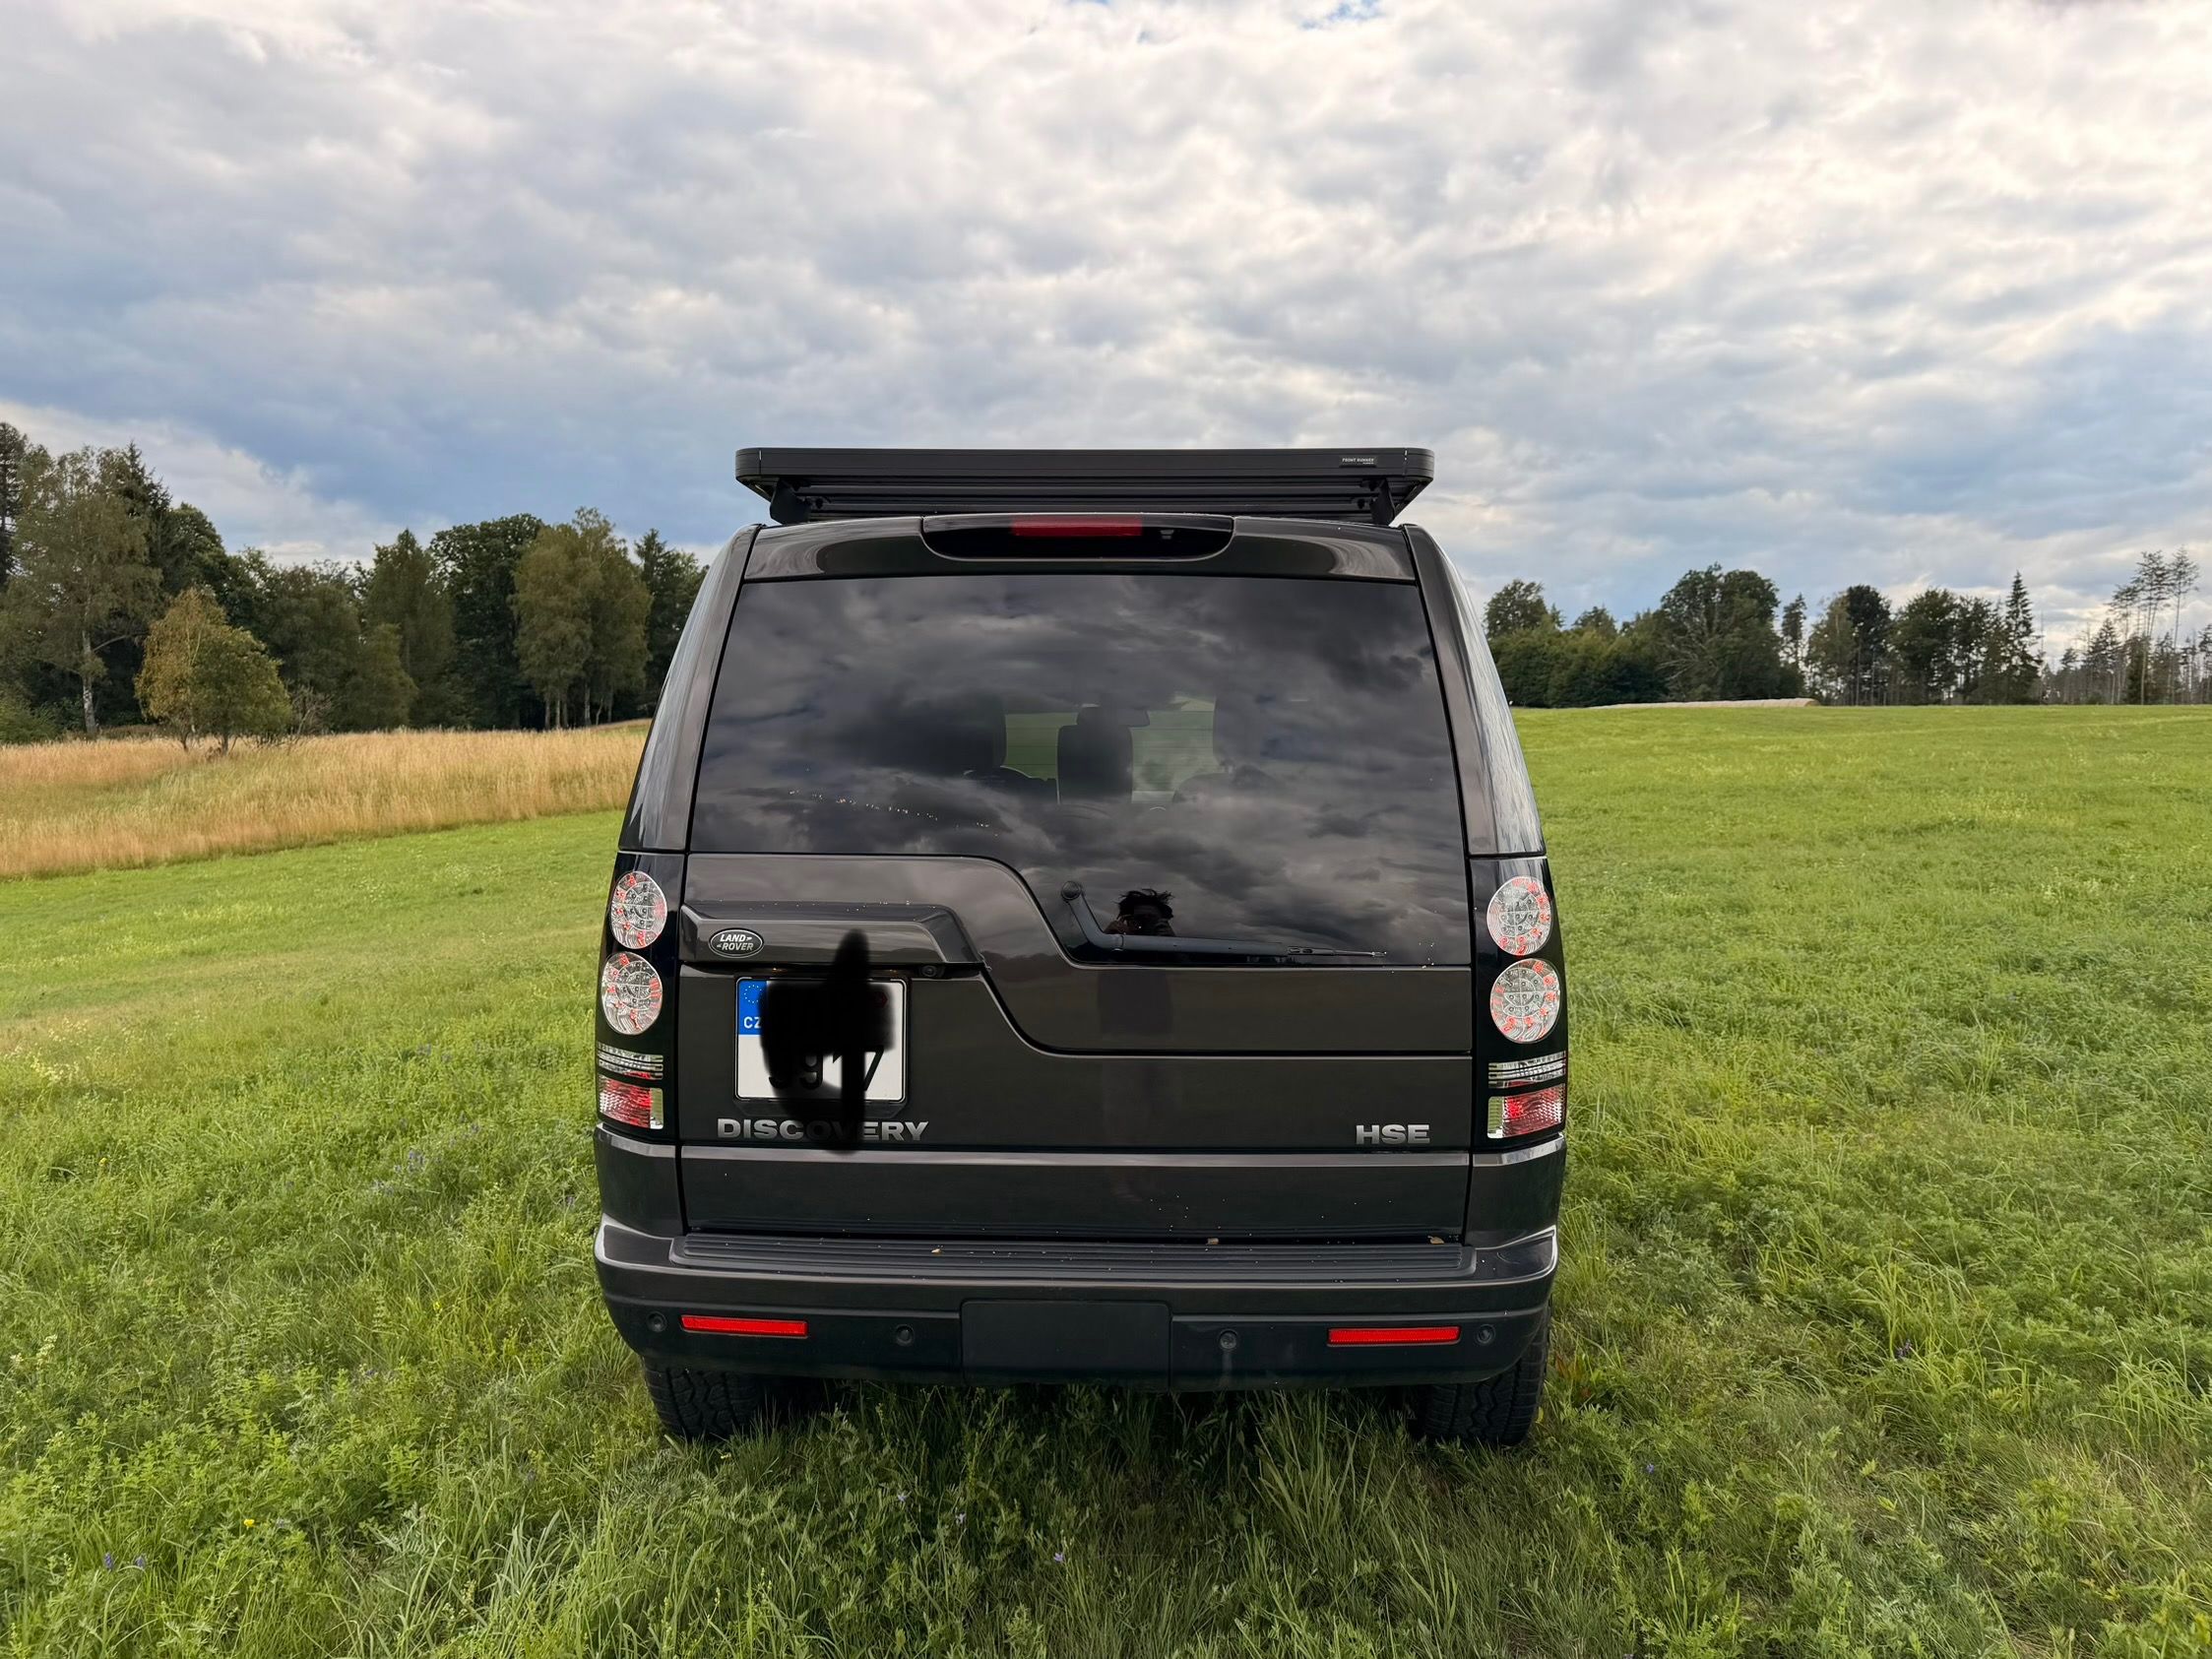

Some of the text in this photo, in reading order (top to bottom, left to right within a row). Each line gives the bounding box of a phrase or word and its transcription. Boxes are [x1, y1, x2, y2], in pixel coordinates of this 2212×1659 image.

[720, 933, 746, 942] LAND
[722, 942, 754, 951] ROVER
[743, 1016, 762, 1029] CZ
[1356, 1123, 1430, 1145] HSE
